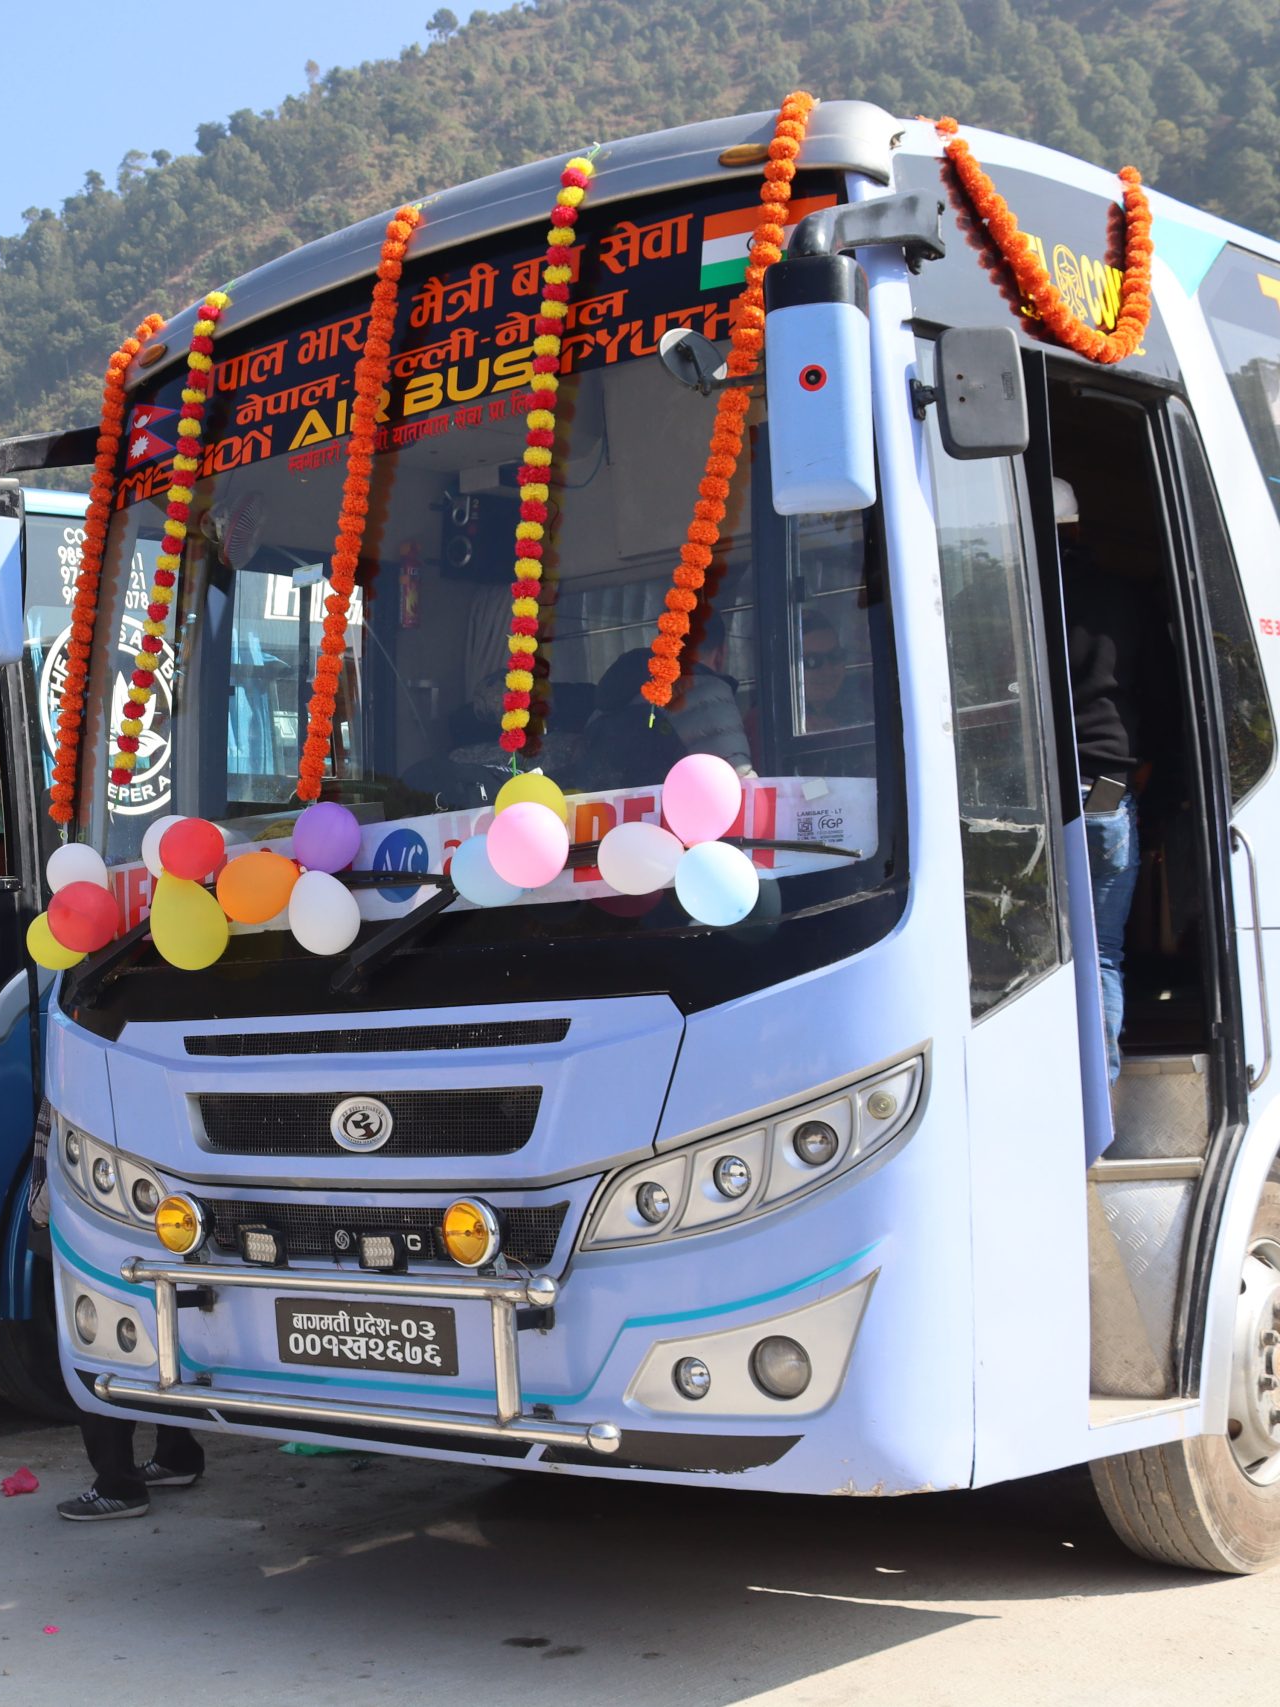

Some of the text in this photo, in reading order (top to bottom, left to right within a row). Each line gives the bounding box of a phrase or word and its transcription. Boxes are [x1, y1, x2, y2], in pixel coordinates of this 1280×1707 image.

[410, 262, 500, 329] मैत्री
[599, 212, 695, 275] सेवा
[403, 345, 534, 416] BUS
[292, 1310, 350, 1333] बागमती
